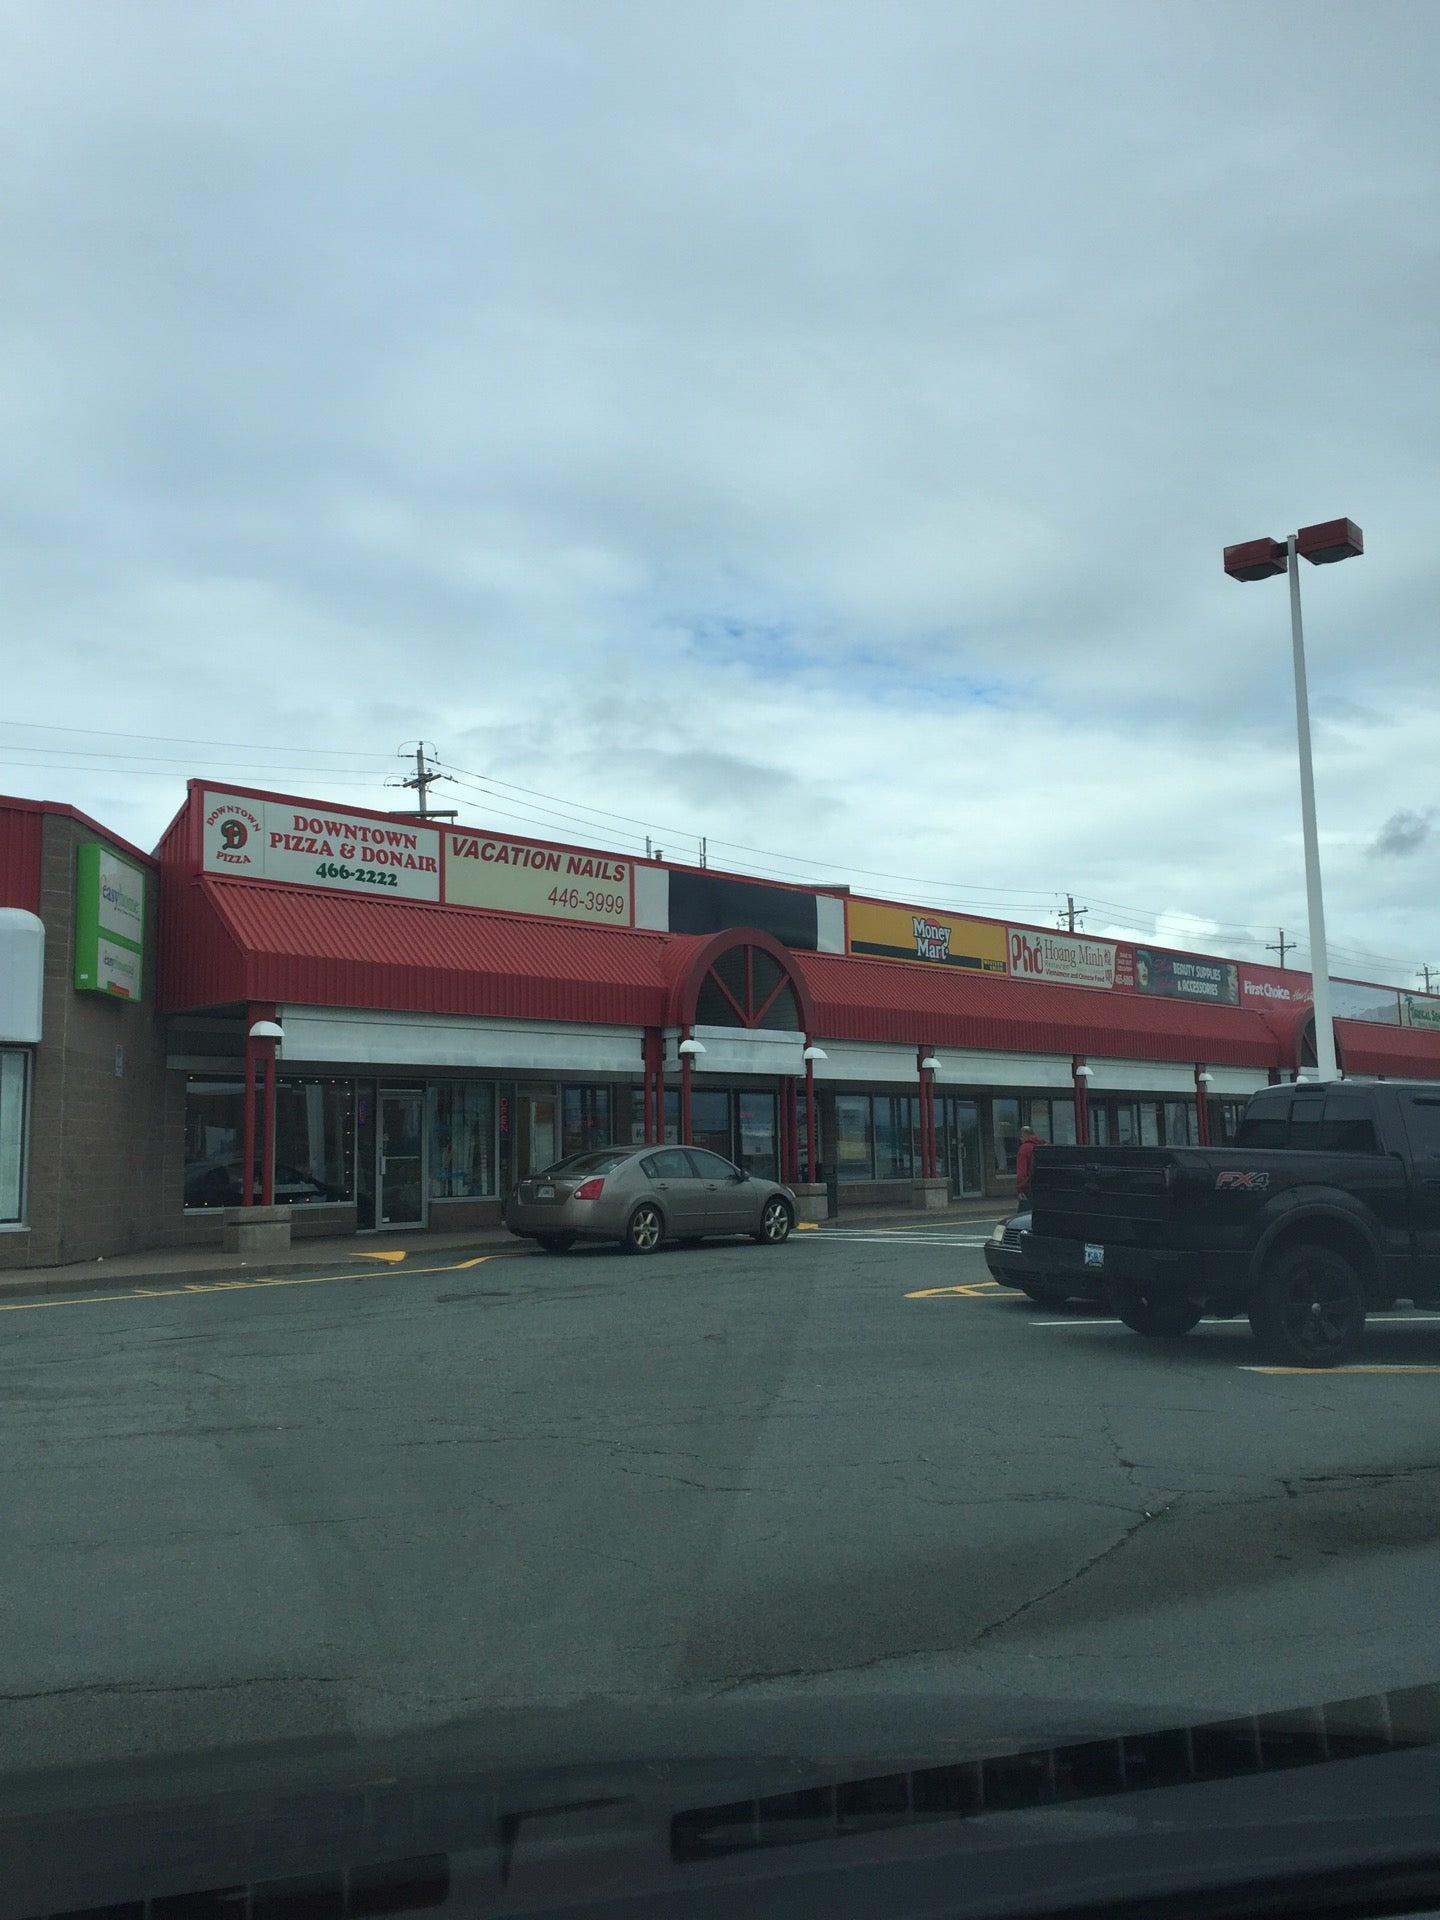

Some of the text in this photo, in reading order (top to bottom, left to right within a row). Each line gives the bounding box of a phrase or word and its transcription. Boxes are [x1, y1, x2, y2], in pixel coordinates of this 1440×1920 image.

[206, 805, 261, 832] DOWNTOWN
[293, 815, 417, 850] DOWNTOWN
[216, 851, 251, 865] PIZZA
[269, 832, 438, 873] PIZZA & DONAIR
[452, 837, 626, 882] VACATION NAILS
[315, 862, 398, 887] 466-2222
[548, 886, 624, 915] 446-3999
[912, 917, 951, 947] Money
[916, 938, 948, 960] Mart
[1045, 939, 1076, 967] Hoang
[1078, 945, 1104, 967] Minh
[1173, 962, 1195, 977] BEAUTY
[1195, 965, 1221, 981] SUPPLIES
[1182, 980, 1218, 996] ACCESSORIES
[1244, 980, 1264, 996] First
[1264, 983, 1290, 1000] Choice
[1216, 1171, 1269, 1188] FX4
